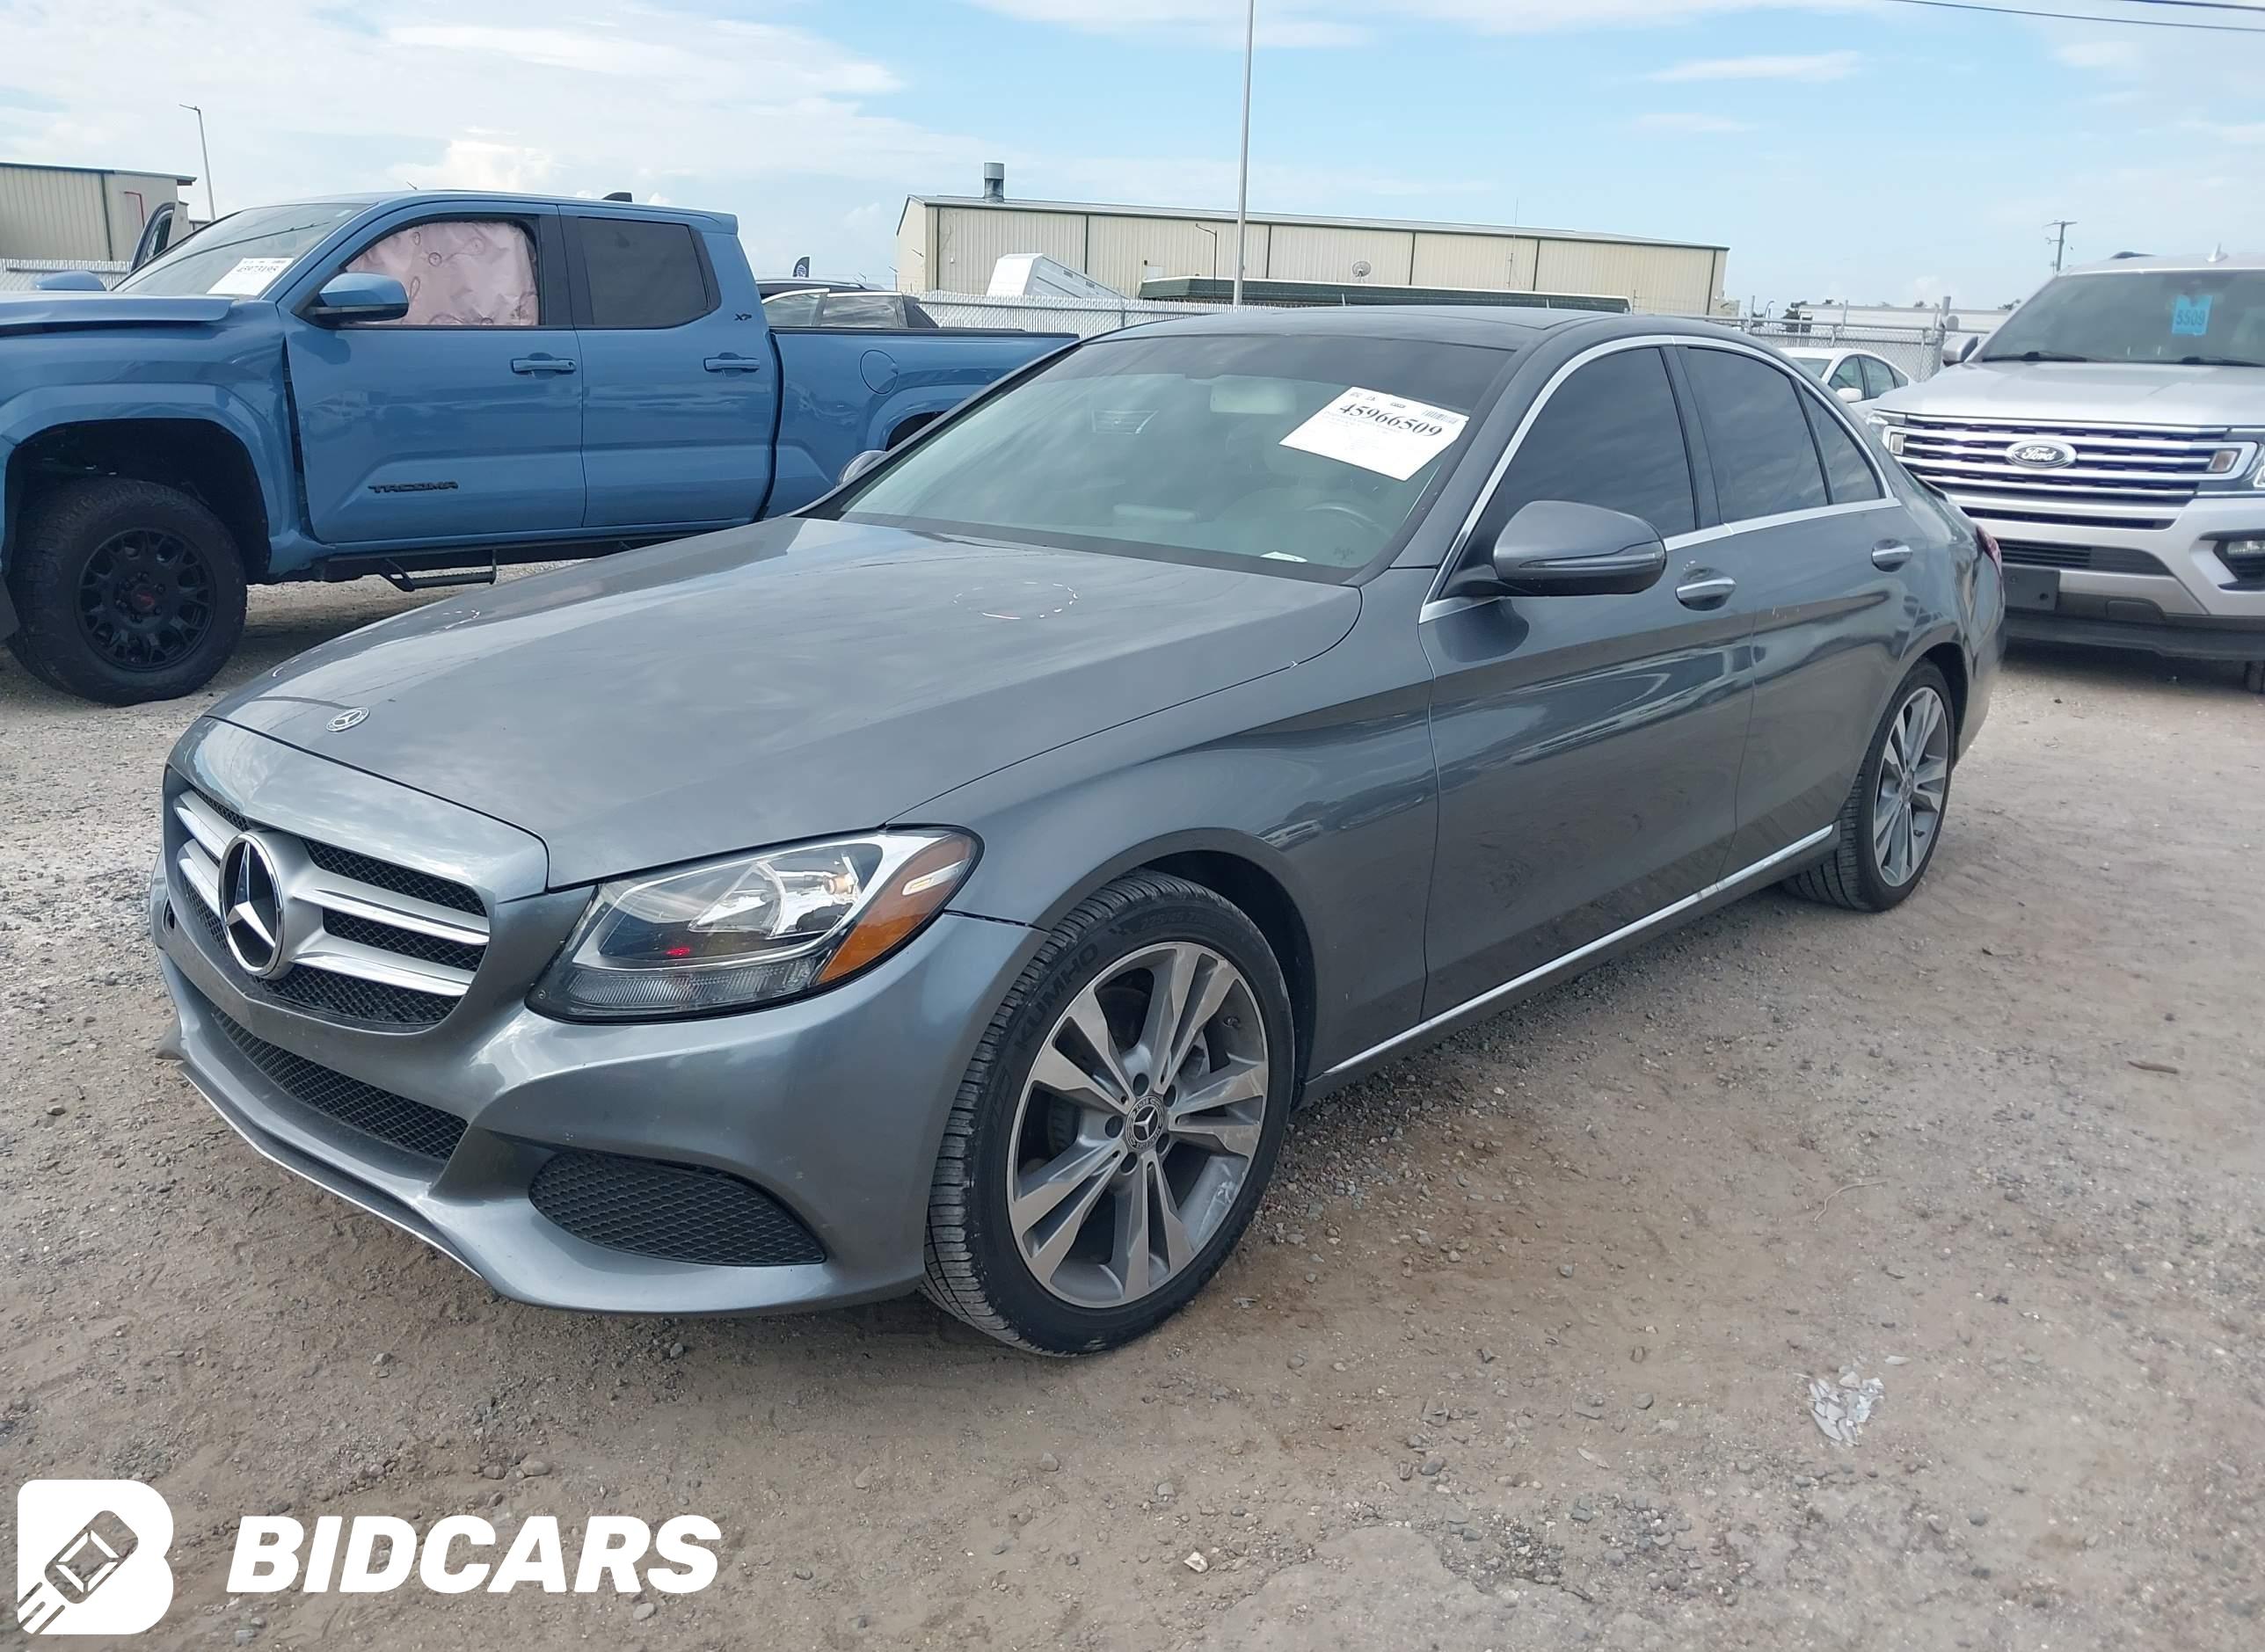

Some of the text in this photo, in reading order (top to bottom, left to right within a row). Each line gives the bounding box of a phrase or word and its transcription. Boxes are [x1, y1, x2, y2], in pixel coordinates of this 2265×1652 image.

[1337, 403, 1443, 437] 45966509
[2021, 447, 2057, 462] Ford
[368, 481, 459, 493] TACOMA
[1015, 942, 1098, 1049] KUMHO
